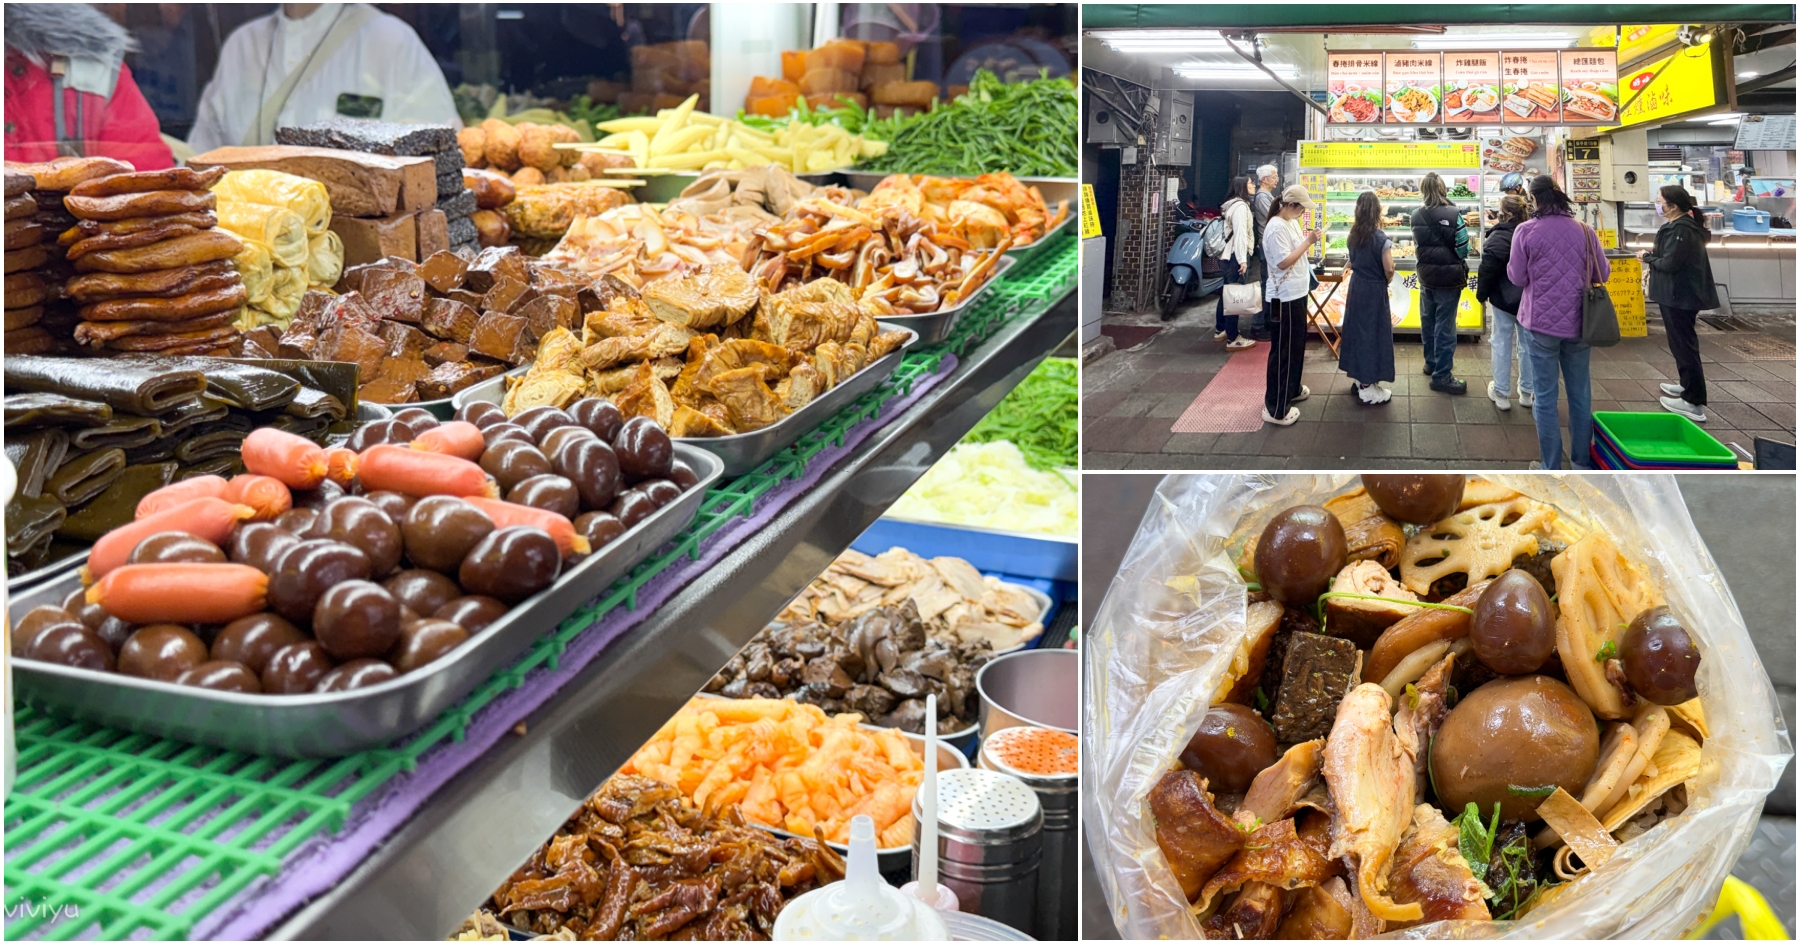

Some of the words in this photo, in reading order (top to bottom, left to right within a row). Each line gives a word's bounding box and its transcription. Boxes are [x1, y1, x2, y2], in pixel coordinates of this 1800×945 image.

[1332, 59, 1379, 68] 春捲排骨米線
[1393, 59, 1433, 68] 滷豬肉米線
[1455, 58, 1487, 67] 炸雞腿飯
[1504, 56, 1528, 64] 炸春捲
[1573, 57, 1605, 65] 總匯麵包
[1504, 67, 1528, 76] 生春捲
[1581, 148, 1591, 159] 7
